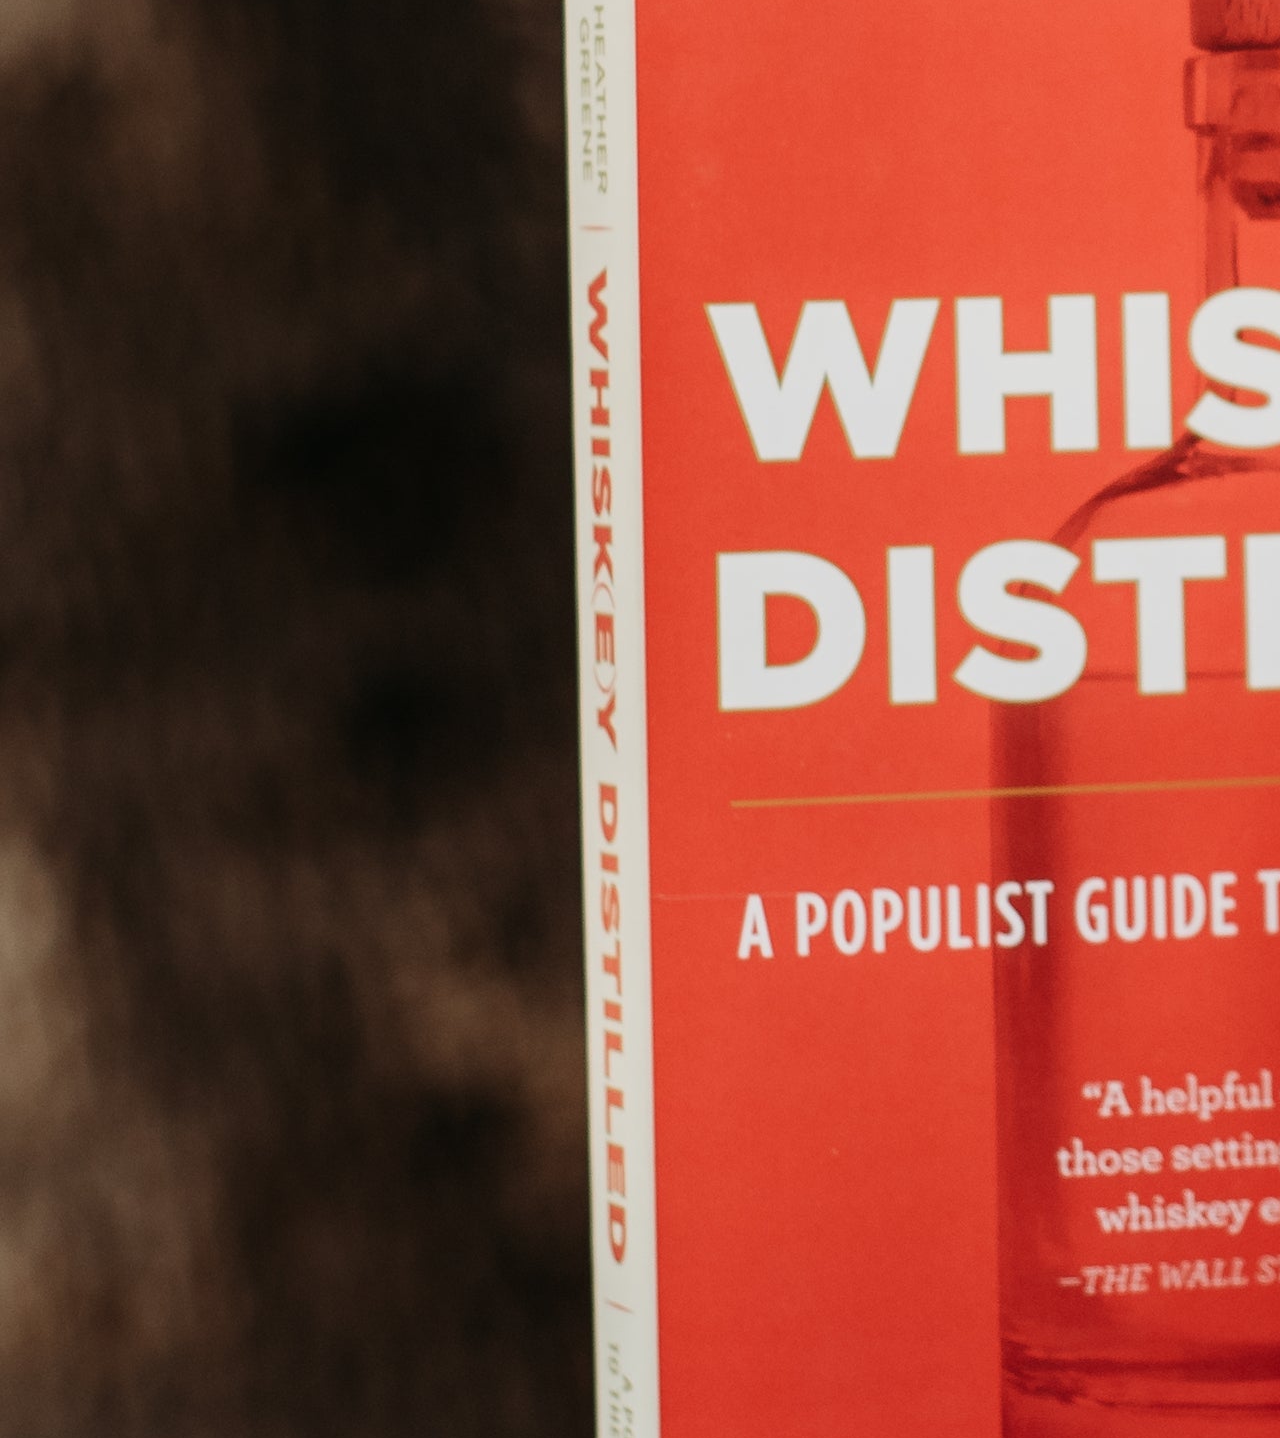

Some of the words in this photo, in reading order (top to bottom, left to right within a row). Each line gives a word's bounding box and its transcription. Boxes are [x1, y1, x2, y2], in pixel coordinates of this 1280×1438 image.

[579, 17, 593, 182] GREENE
[593, 4, 608, 195] HEATHER
[586, 268, 617, 753] WHISK(E)Y
[737, 893, 775, 960] A
[796, 880, 1055, 958] POPULIST
[1075, 872, 1239, 945] GUIDE
[598, 784, 627, 1266] DISTILLED
[1140, 1068, 1275, 1122] helpful
[1056, 1137, 1164, 1178] those
[1095, 1188, 1253, 1236] whiskey
[1158, 1257, 1250, 1289] WALL
[608, 1342, 621, 1375] TO
[609, 1388, 622, 1438] THE
